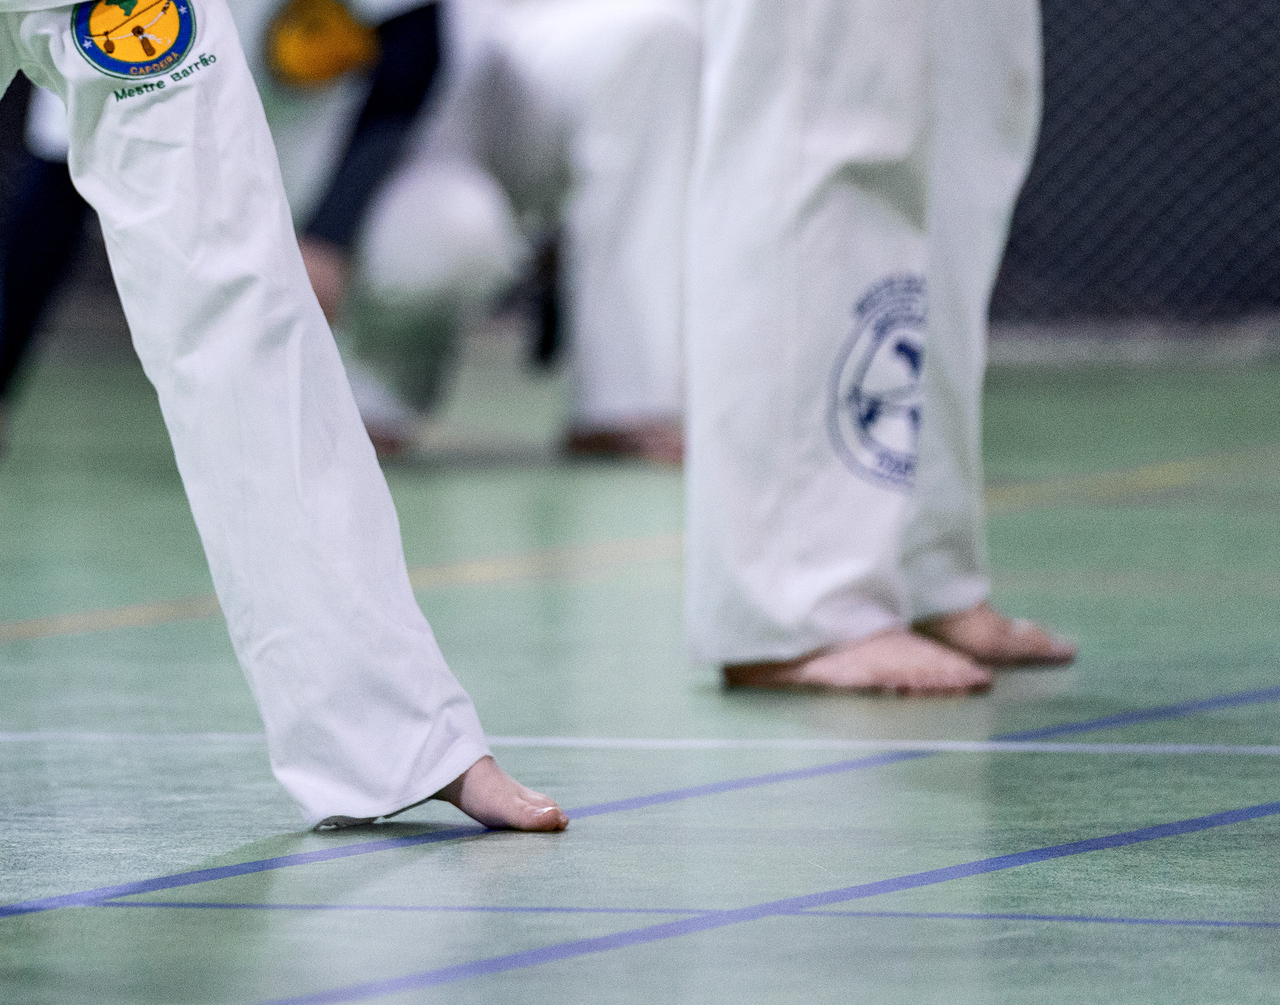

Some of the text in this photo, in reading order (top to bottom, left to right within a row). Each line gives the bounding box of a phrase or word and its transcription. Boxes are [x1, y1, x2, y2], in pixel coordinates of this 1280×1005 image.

[113, 53, 217, 102] Mestre Barrão
[129, 52, 179, 75] CAPOEIRA
